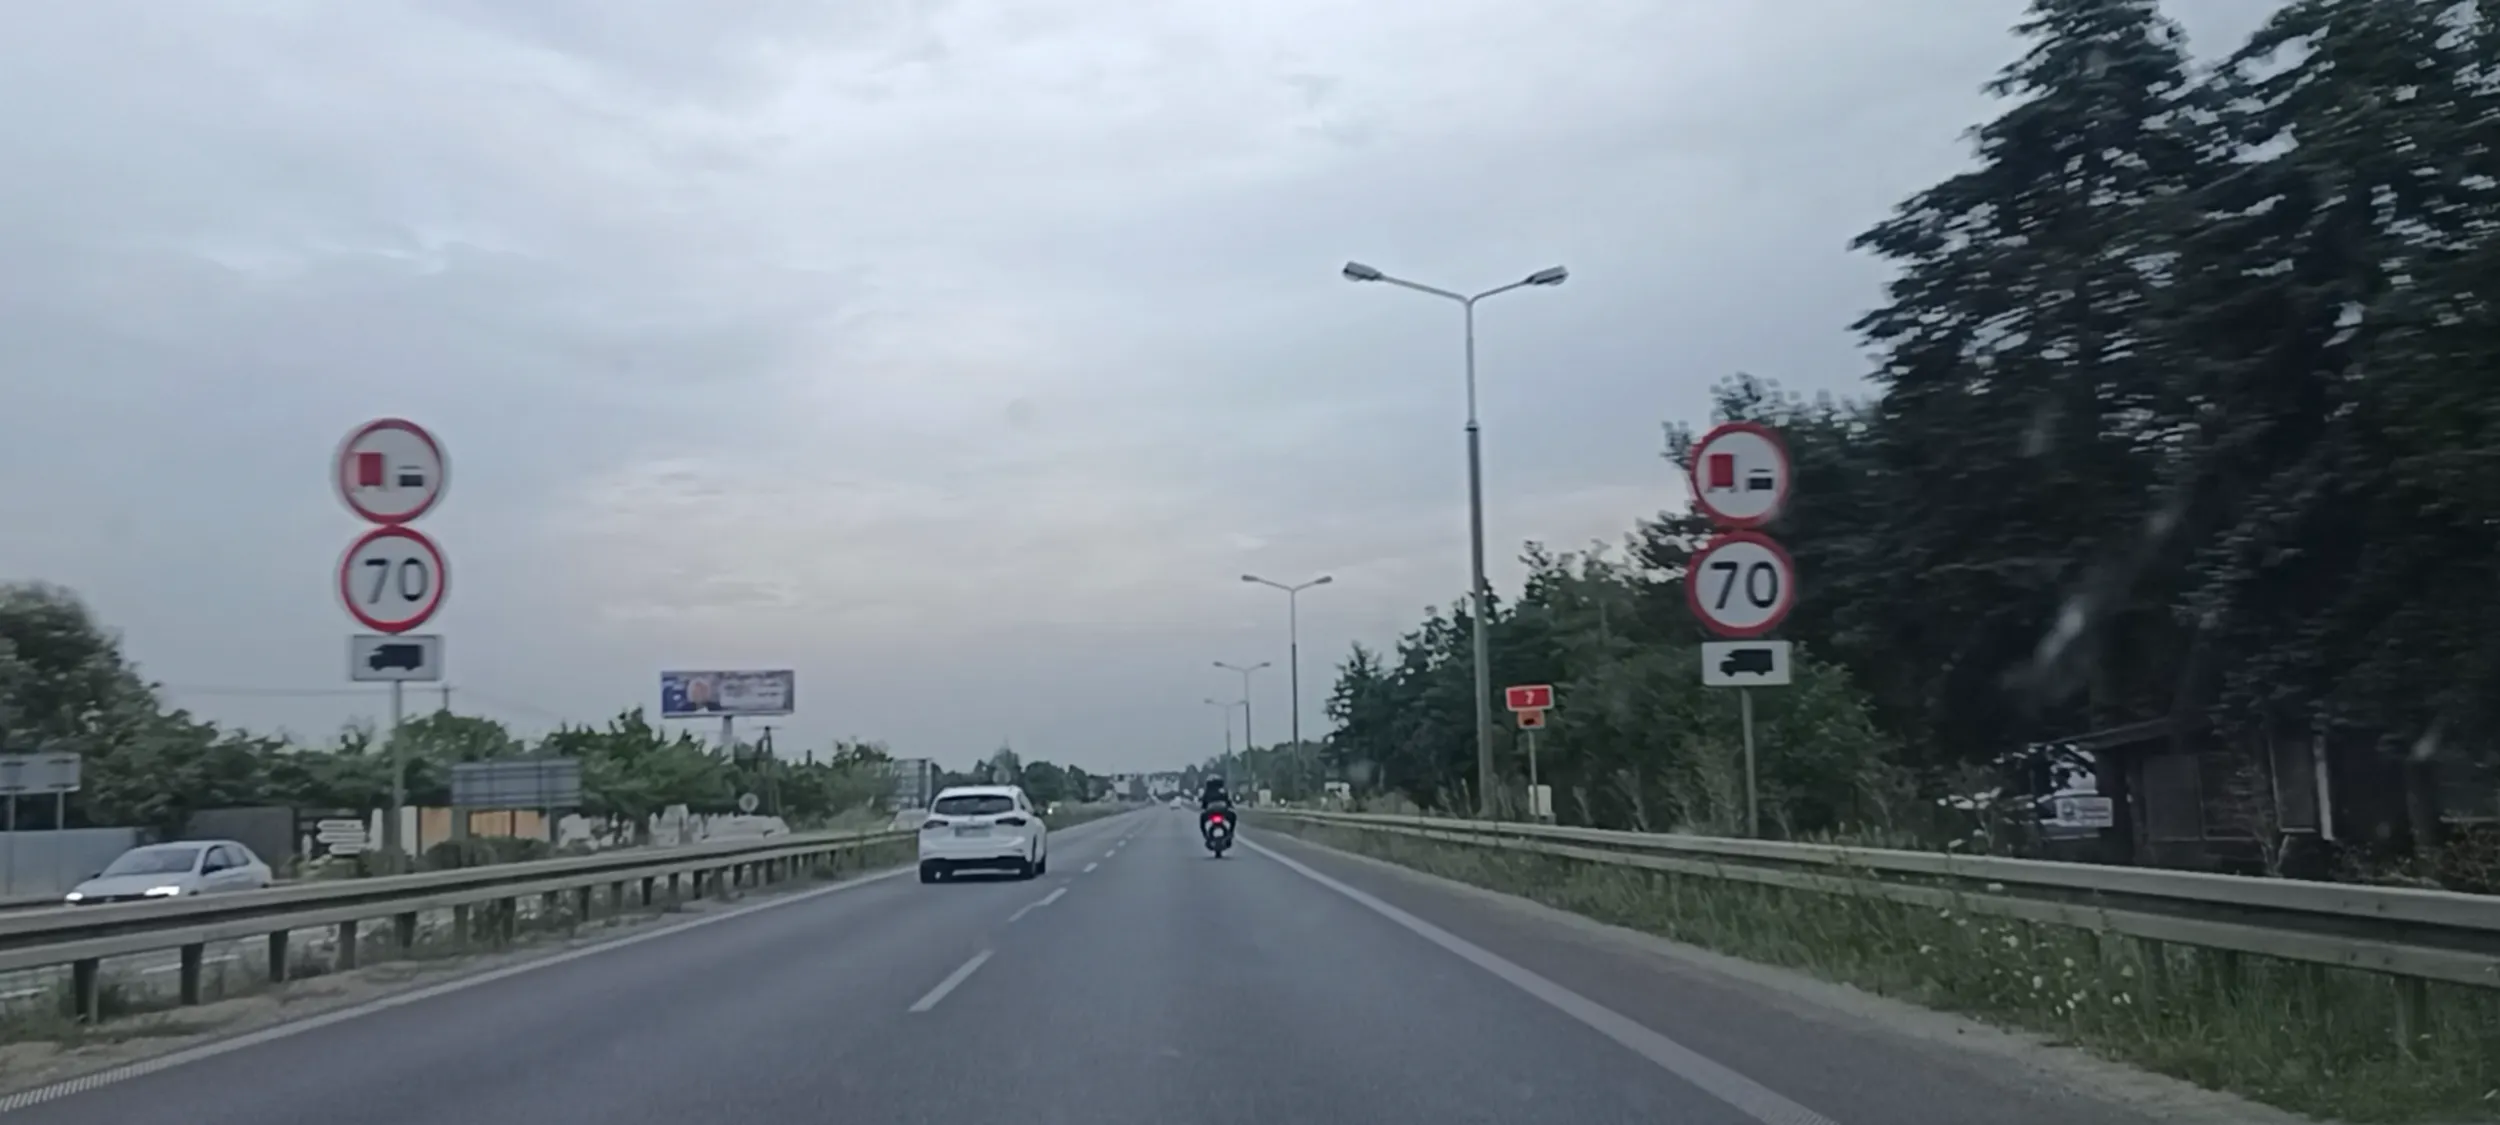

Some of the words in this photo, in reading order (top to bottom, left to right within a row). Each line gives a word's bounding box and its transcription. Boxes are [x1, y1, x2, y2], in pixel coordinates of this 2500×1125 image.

[363, 557, 429, 604] 70
[1709, 561, 1778, 609] 70
[1524, 690, 1535, 705] 7
